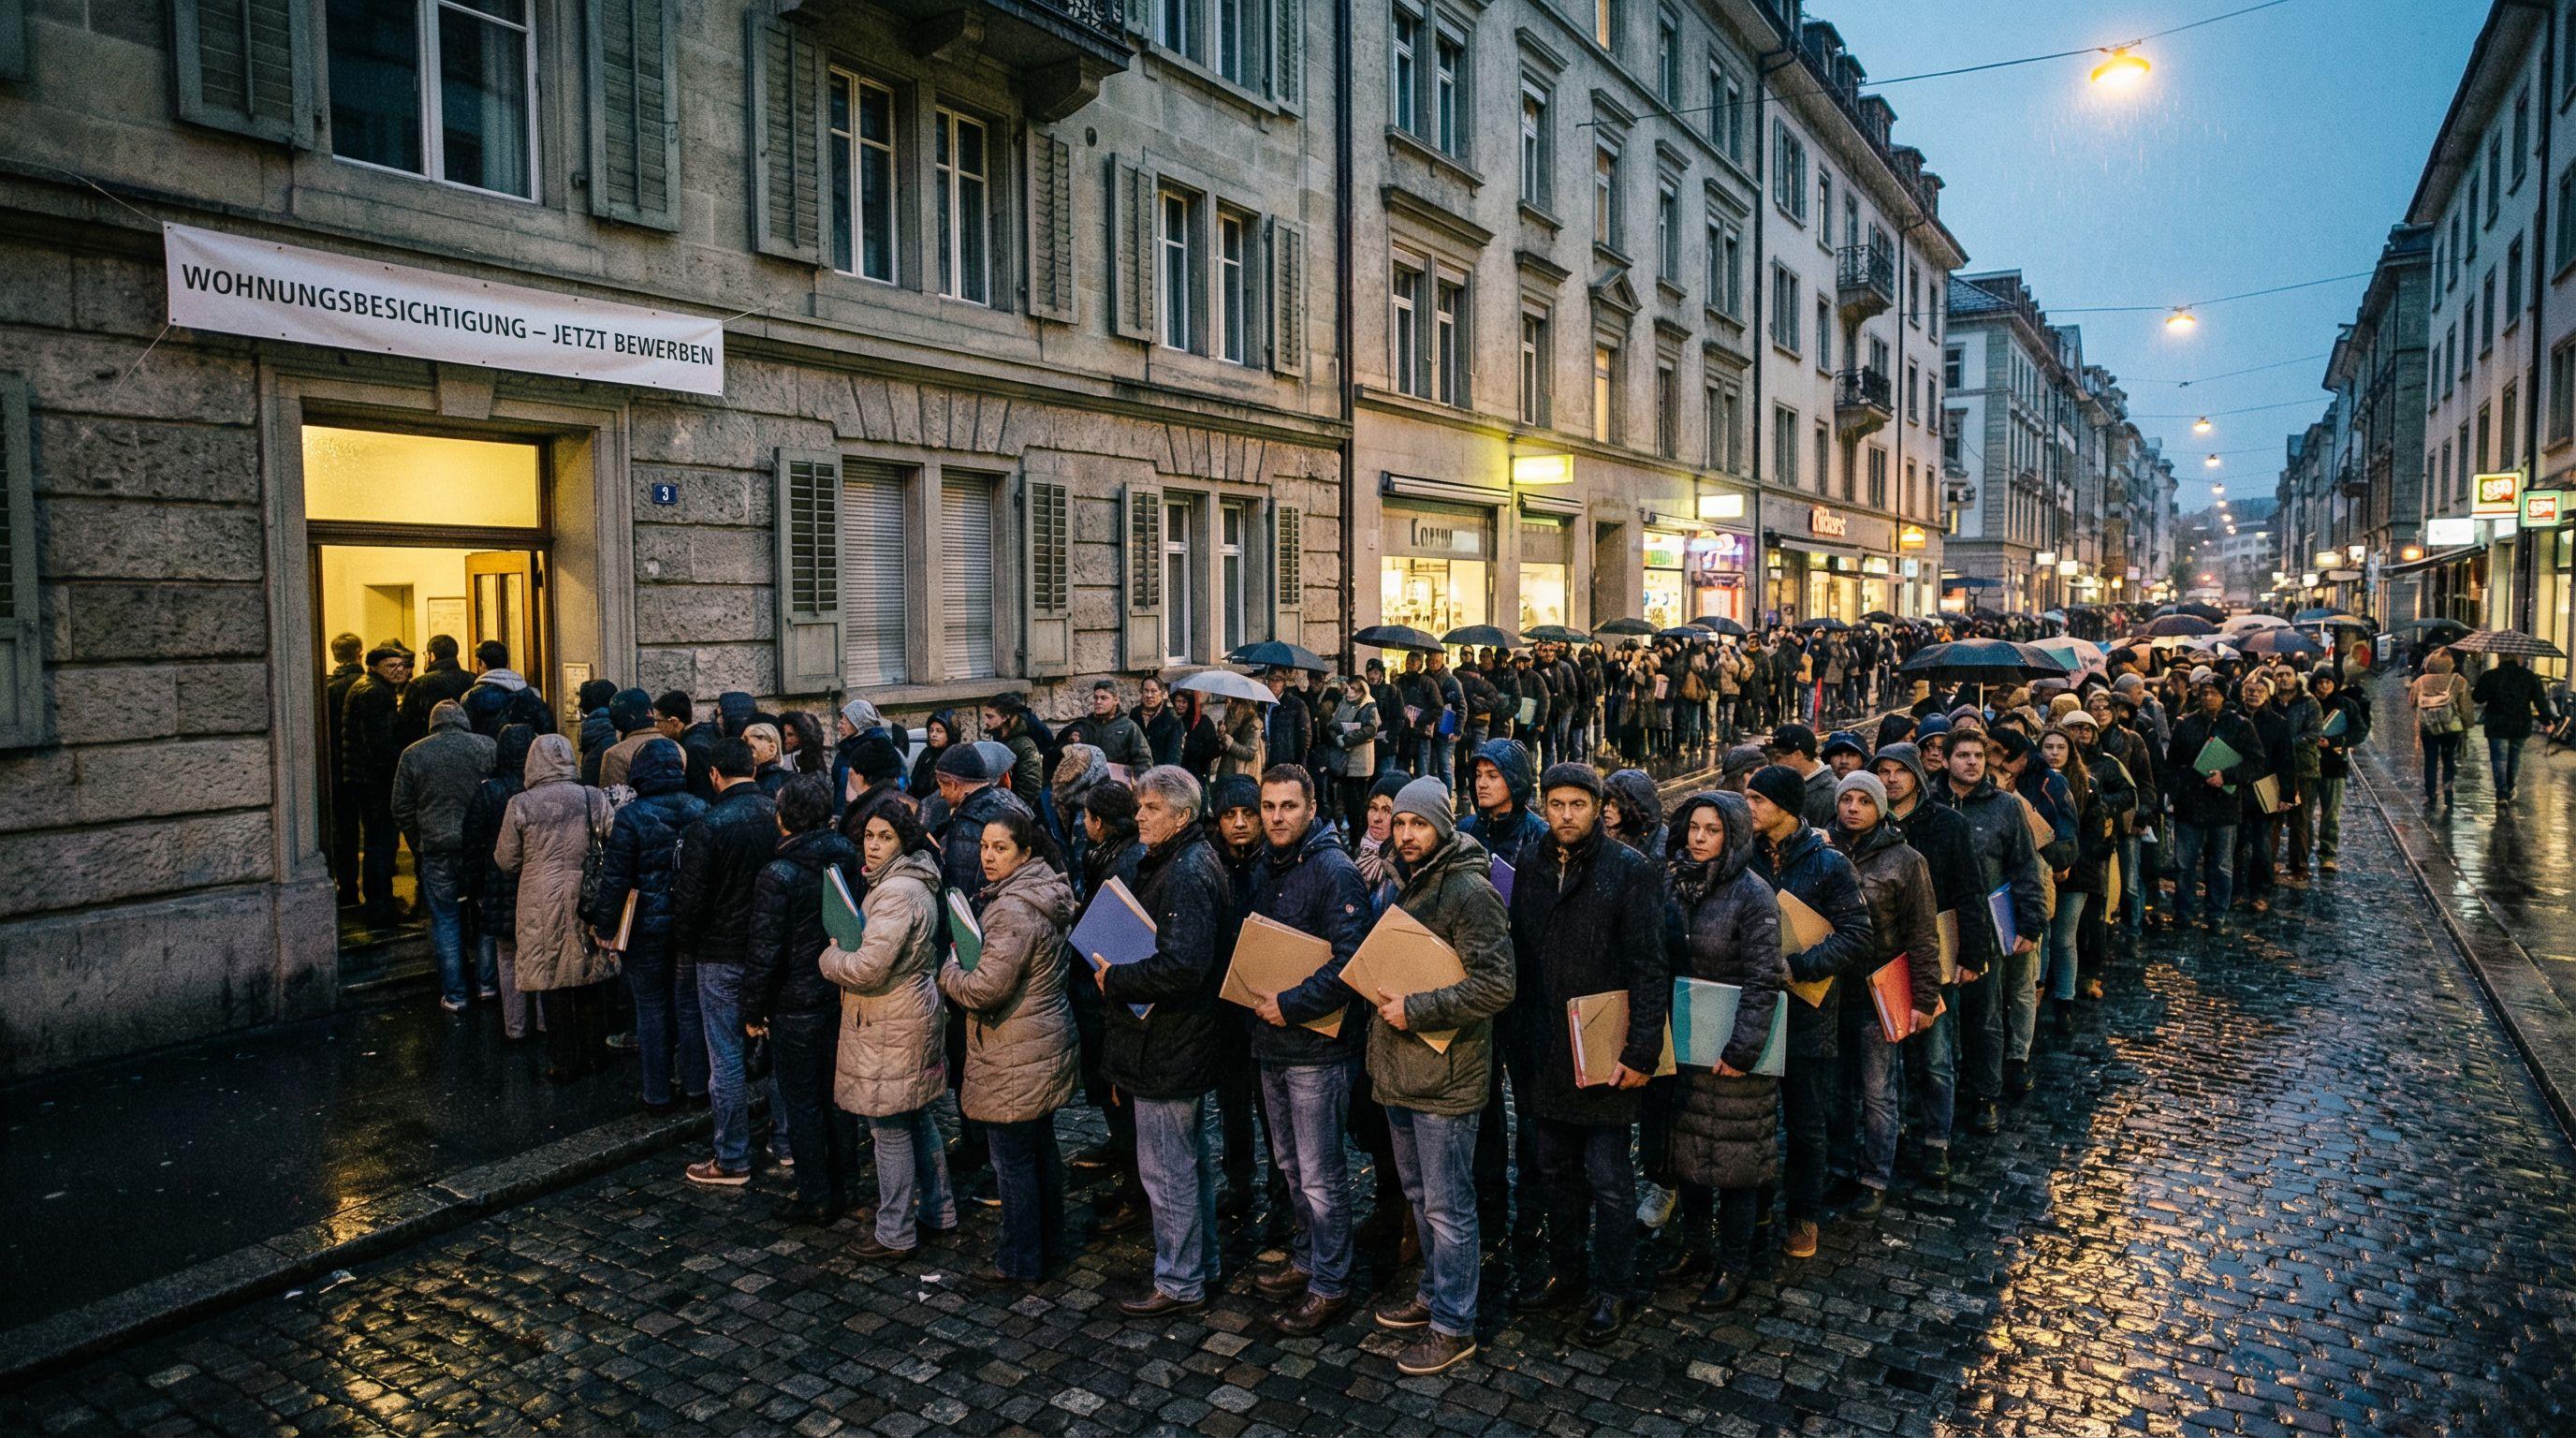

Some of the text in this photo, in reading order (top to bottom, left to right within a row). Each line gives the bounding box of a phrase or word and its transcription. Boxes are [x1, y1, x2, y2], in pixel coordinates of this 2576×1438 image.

[182, 263, 527, 339] WOHNUNGSBESICHTIGUNG
[552, 324, 607, 350] JETZT
[614, 332, 714, 366] BEWERBEN
[662, 486, 669, 502] 3
